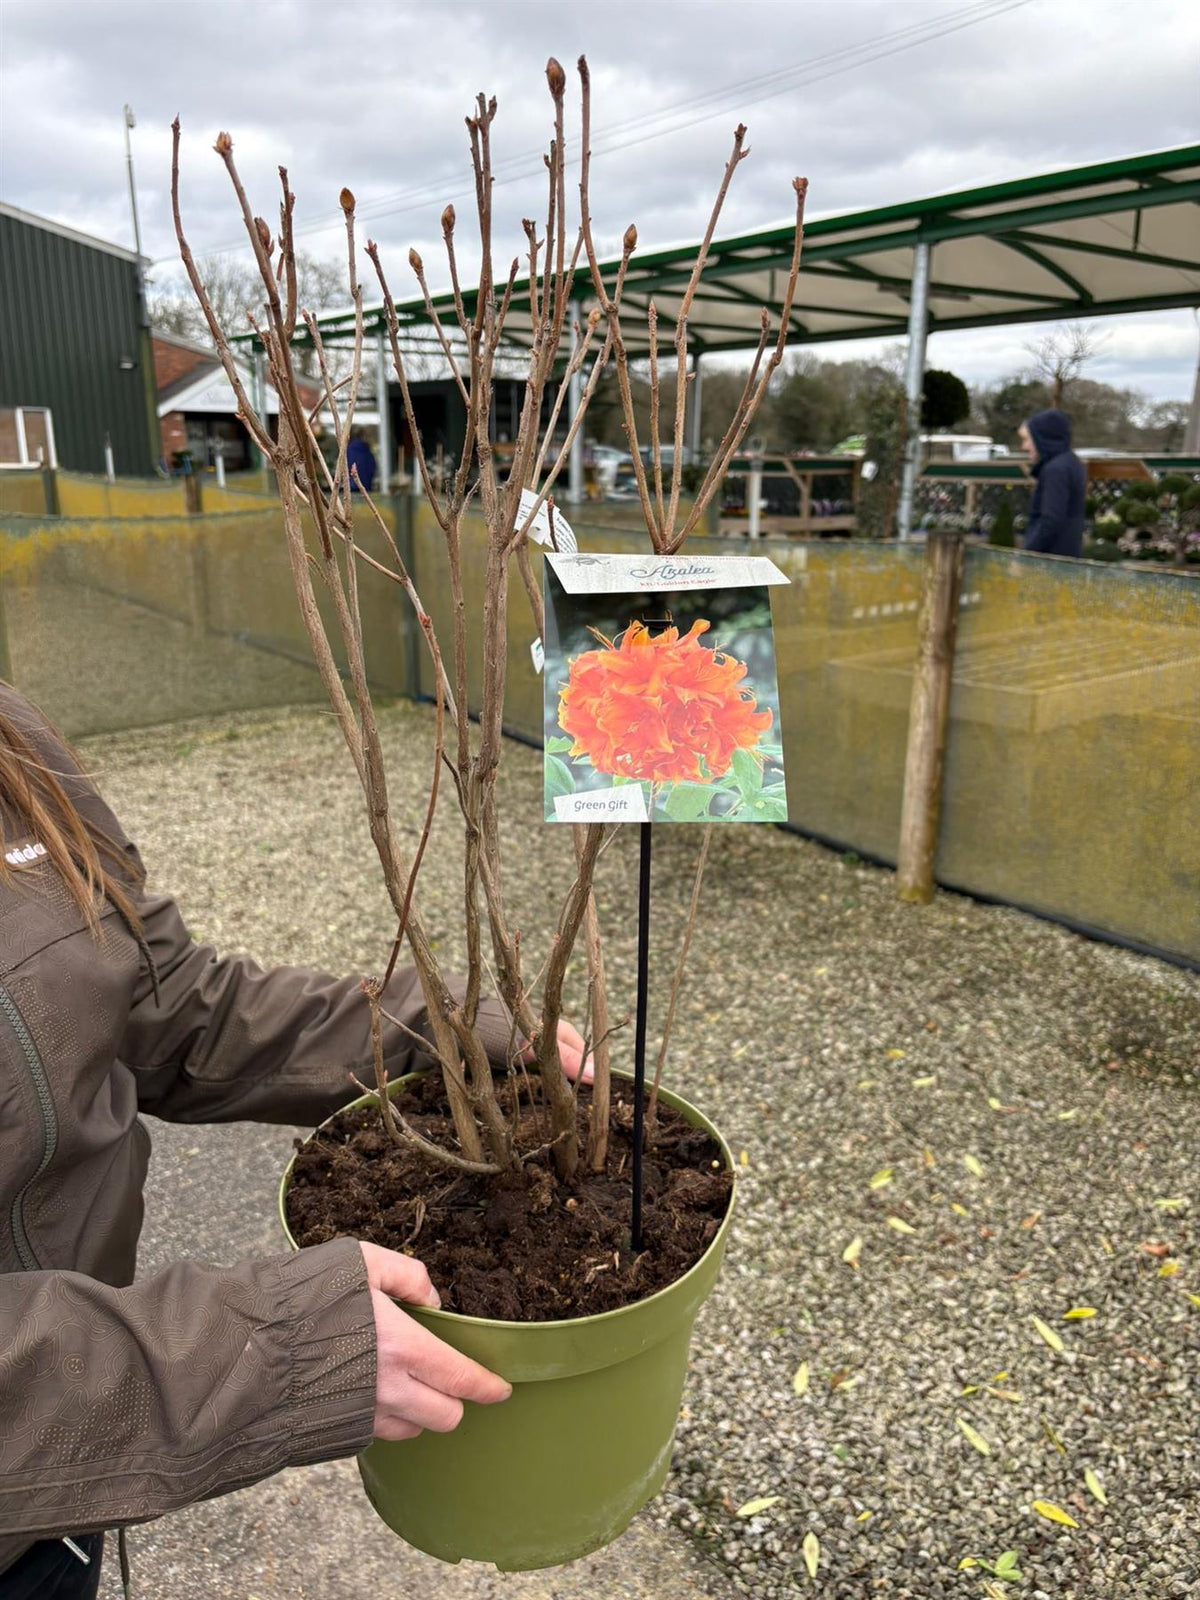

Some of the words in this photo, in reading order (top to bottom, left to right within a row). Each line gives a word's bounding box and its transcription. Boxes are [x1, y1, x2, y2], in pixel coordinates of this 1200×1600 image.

[630, 564, 715, 580] Azalea
[574, 800, 606, 812] Green
[608, 800, 629, 812] Gift
